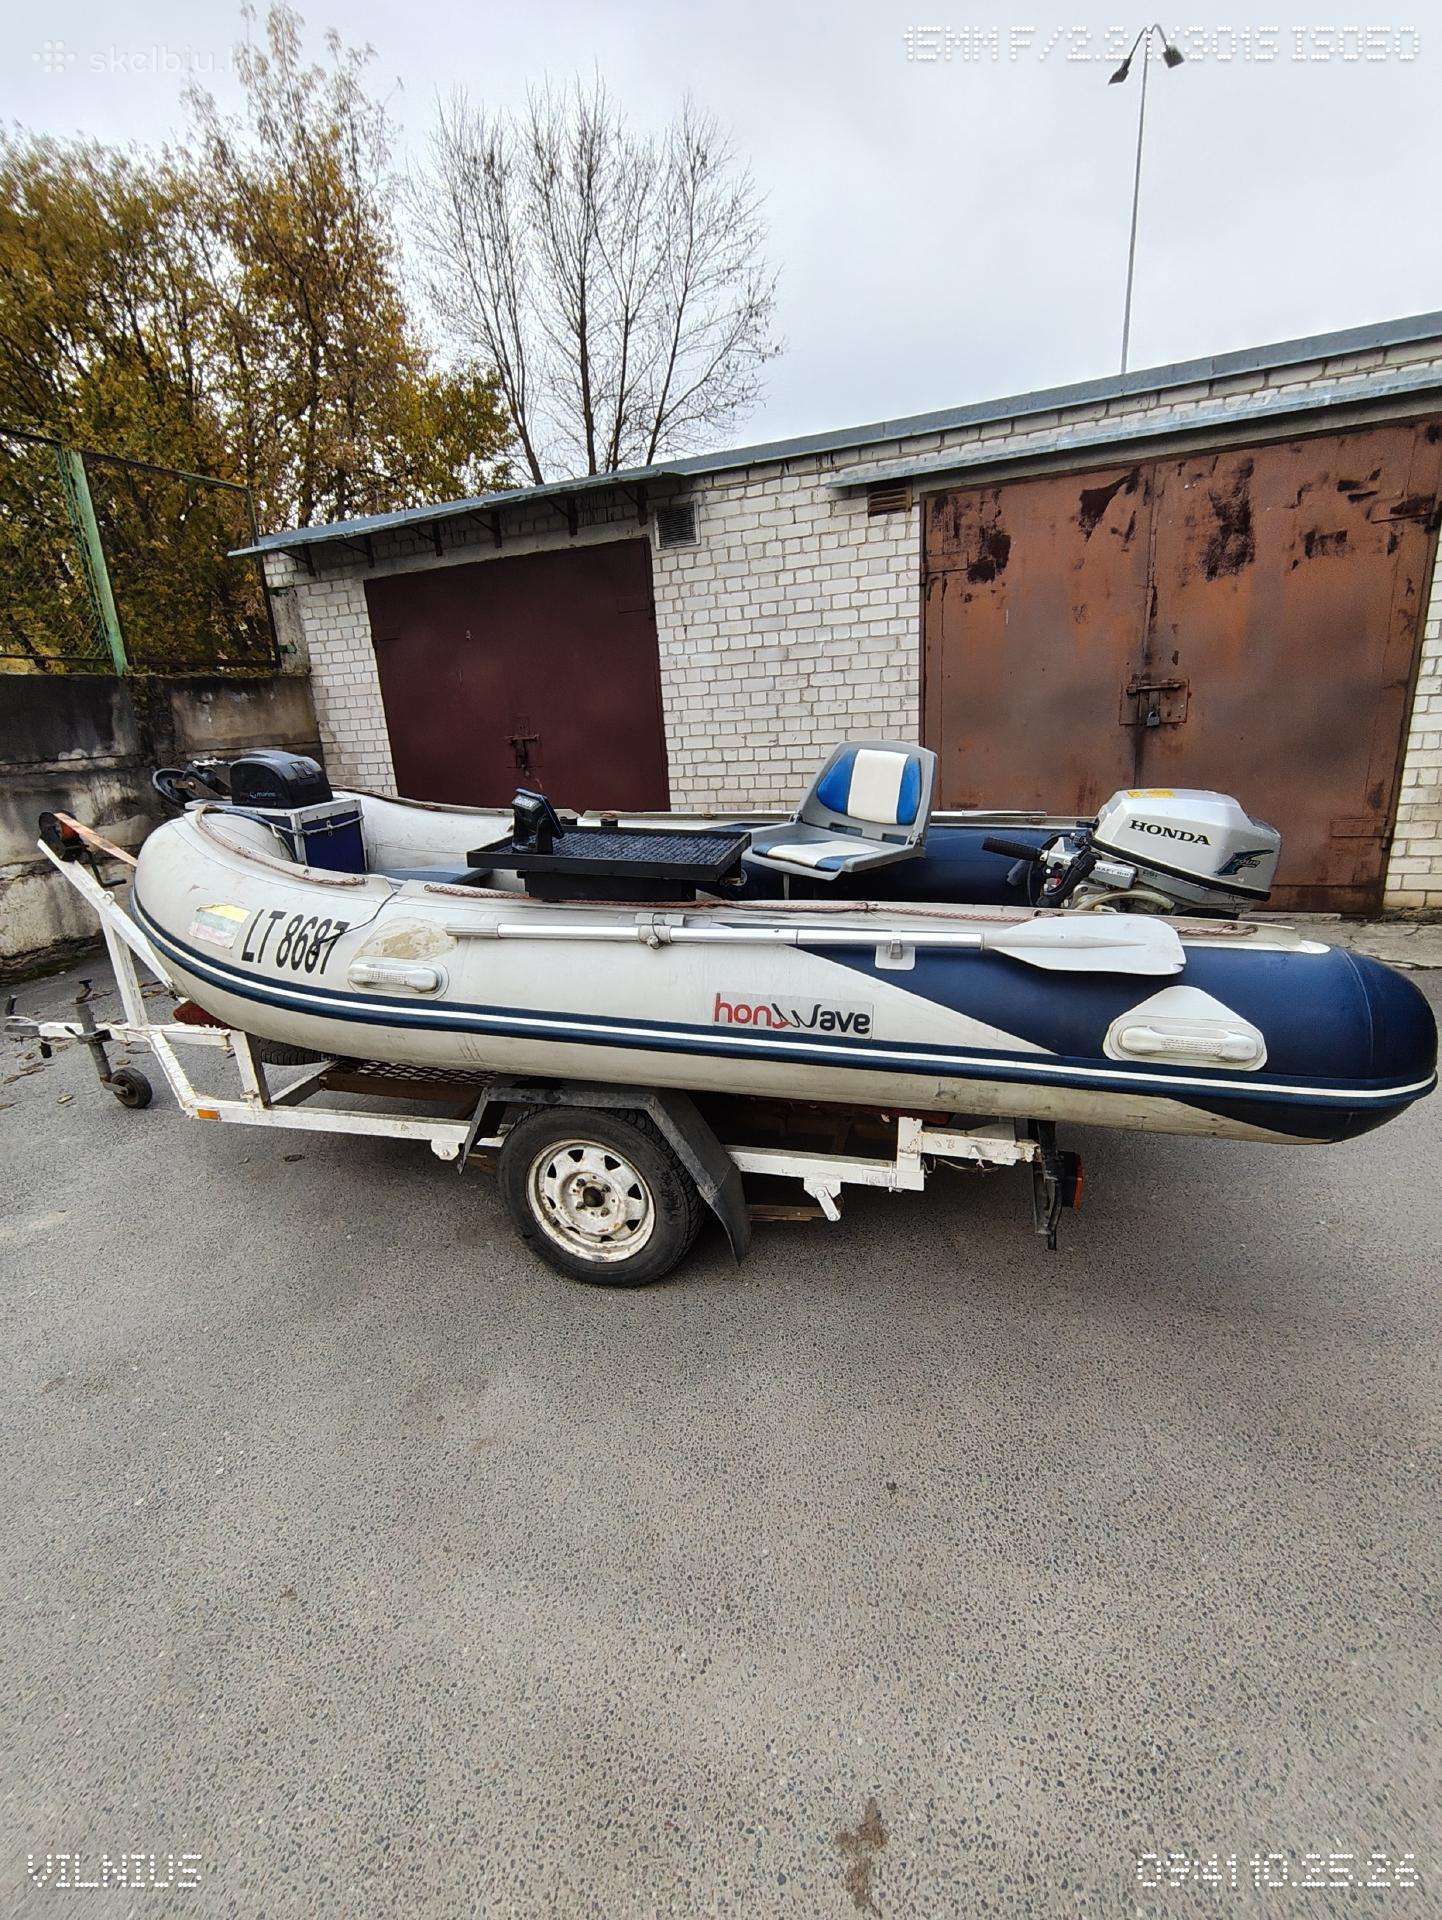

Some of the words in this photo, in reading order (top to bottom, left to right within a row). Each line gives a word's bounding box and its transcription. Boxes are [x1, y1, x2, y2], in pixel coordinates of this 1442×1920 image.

[1128, 819, 1212, 846] HONDA
[241, 909, 287, 964] LT
[276, 914, 350, 975] 8687
